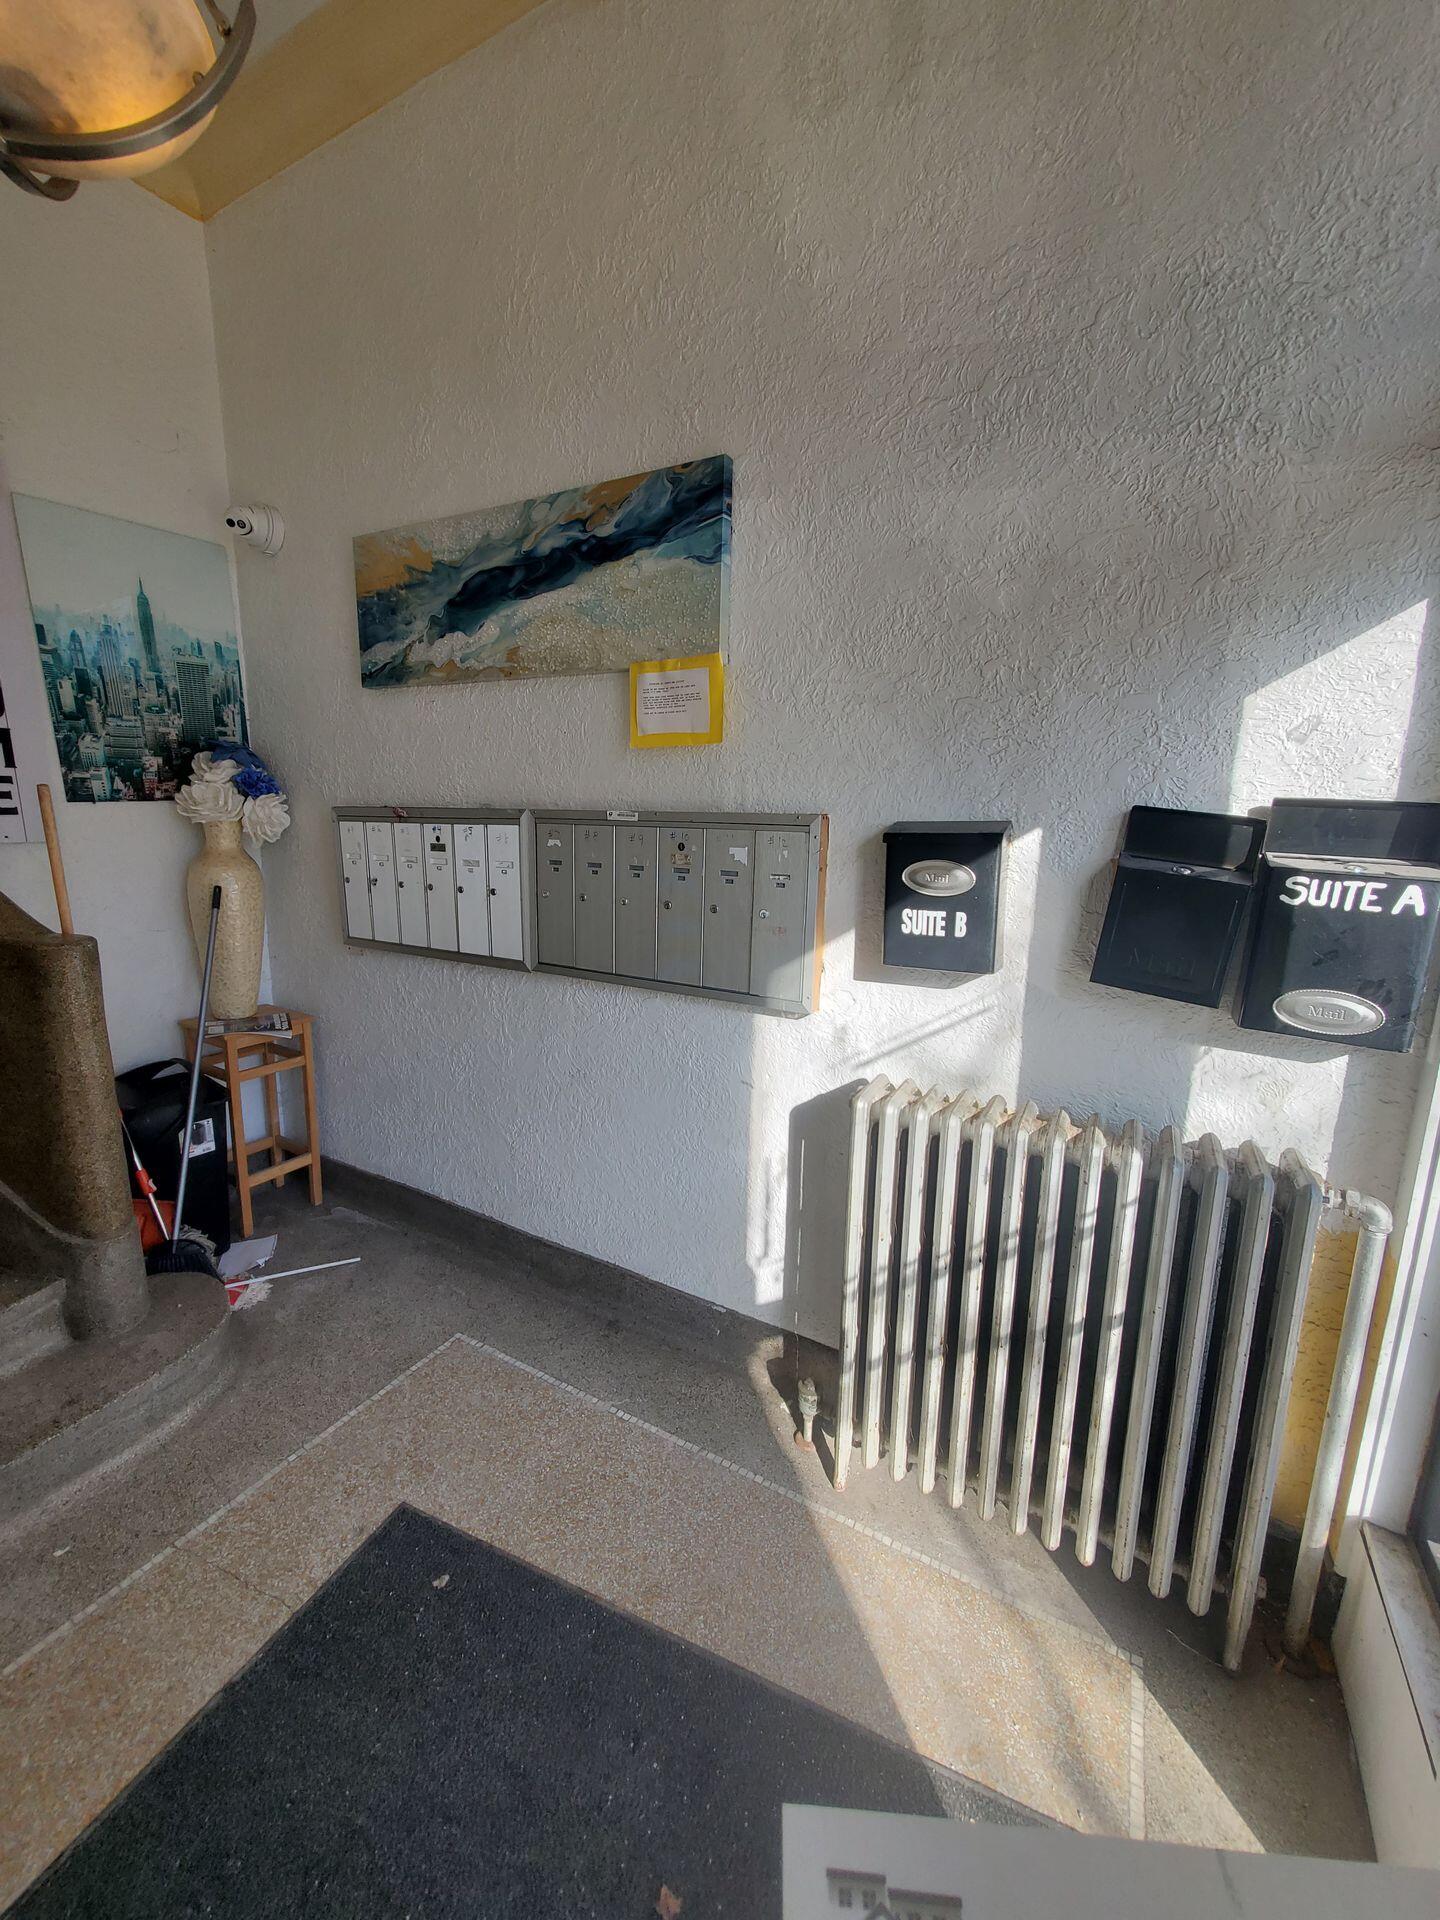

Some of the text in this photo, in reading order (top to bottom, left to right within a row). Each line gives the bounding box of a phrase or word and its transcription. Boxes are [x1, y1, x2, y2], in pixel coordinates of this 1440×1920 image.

[924, 872, 949, 884] Mail
[1279, 875, 1426, 917] SUITE A
[901, 908, 968, 938] SUITE B
[1308, 1005, 1347, 1021] Mail
